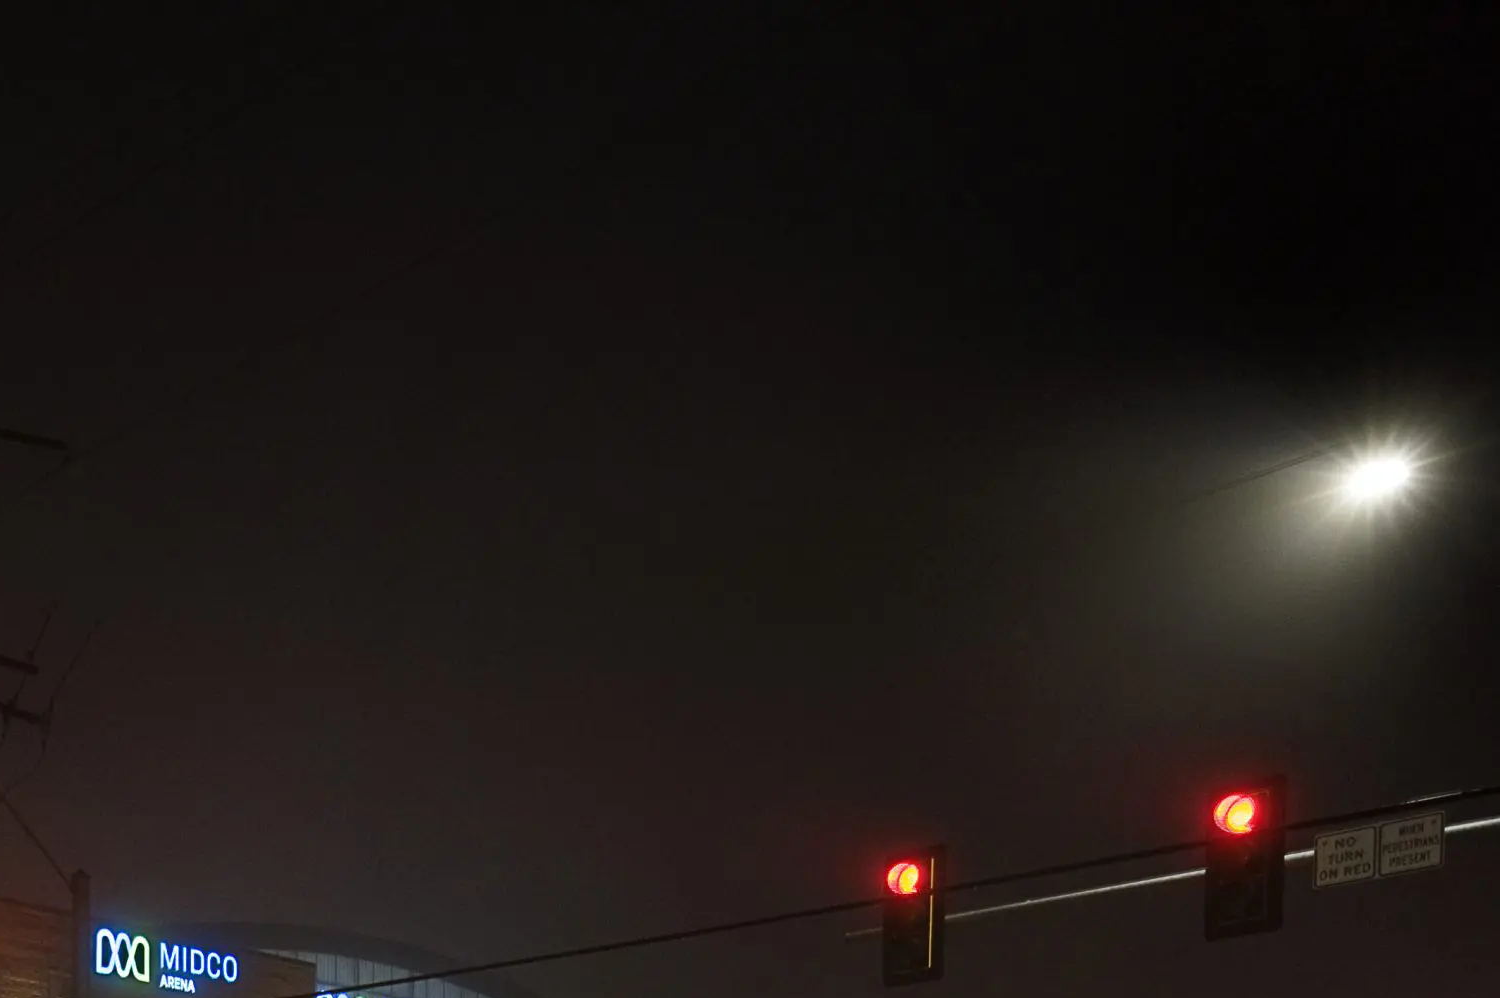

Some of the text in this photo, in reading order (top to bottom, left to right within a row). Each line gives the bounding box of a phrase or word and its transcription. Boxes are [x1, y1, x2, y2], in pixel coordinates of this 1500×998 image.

[1334, 837, 1356, 849] NO
[1328, 848, 1364, 865] TURN
[1388, 850, 1431, 868] PRESENT
[1319, 862, 1371, 881] ON RED
[160, 942, 238, 983] MIDCO
[159, 974, 196, 993] ARENA
